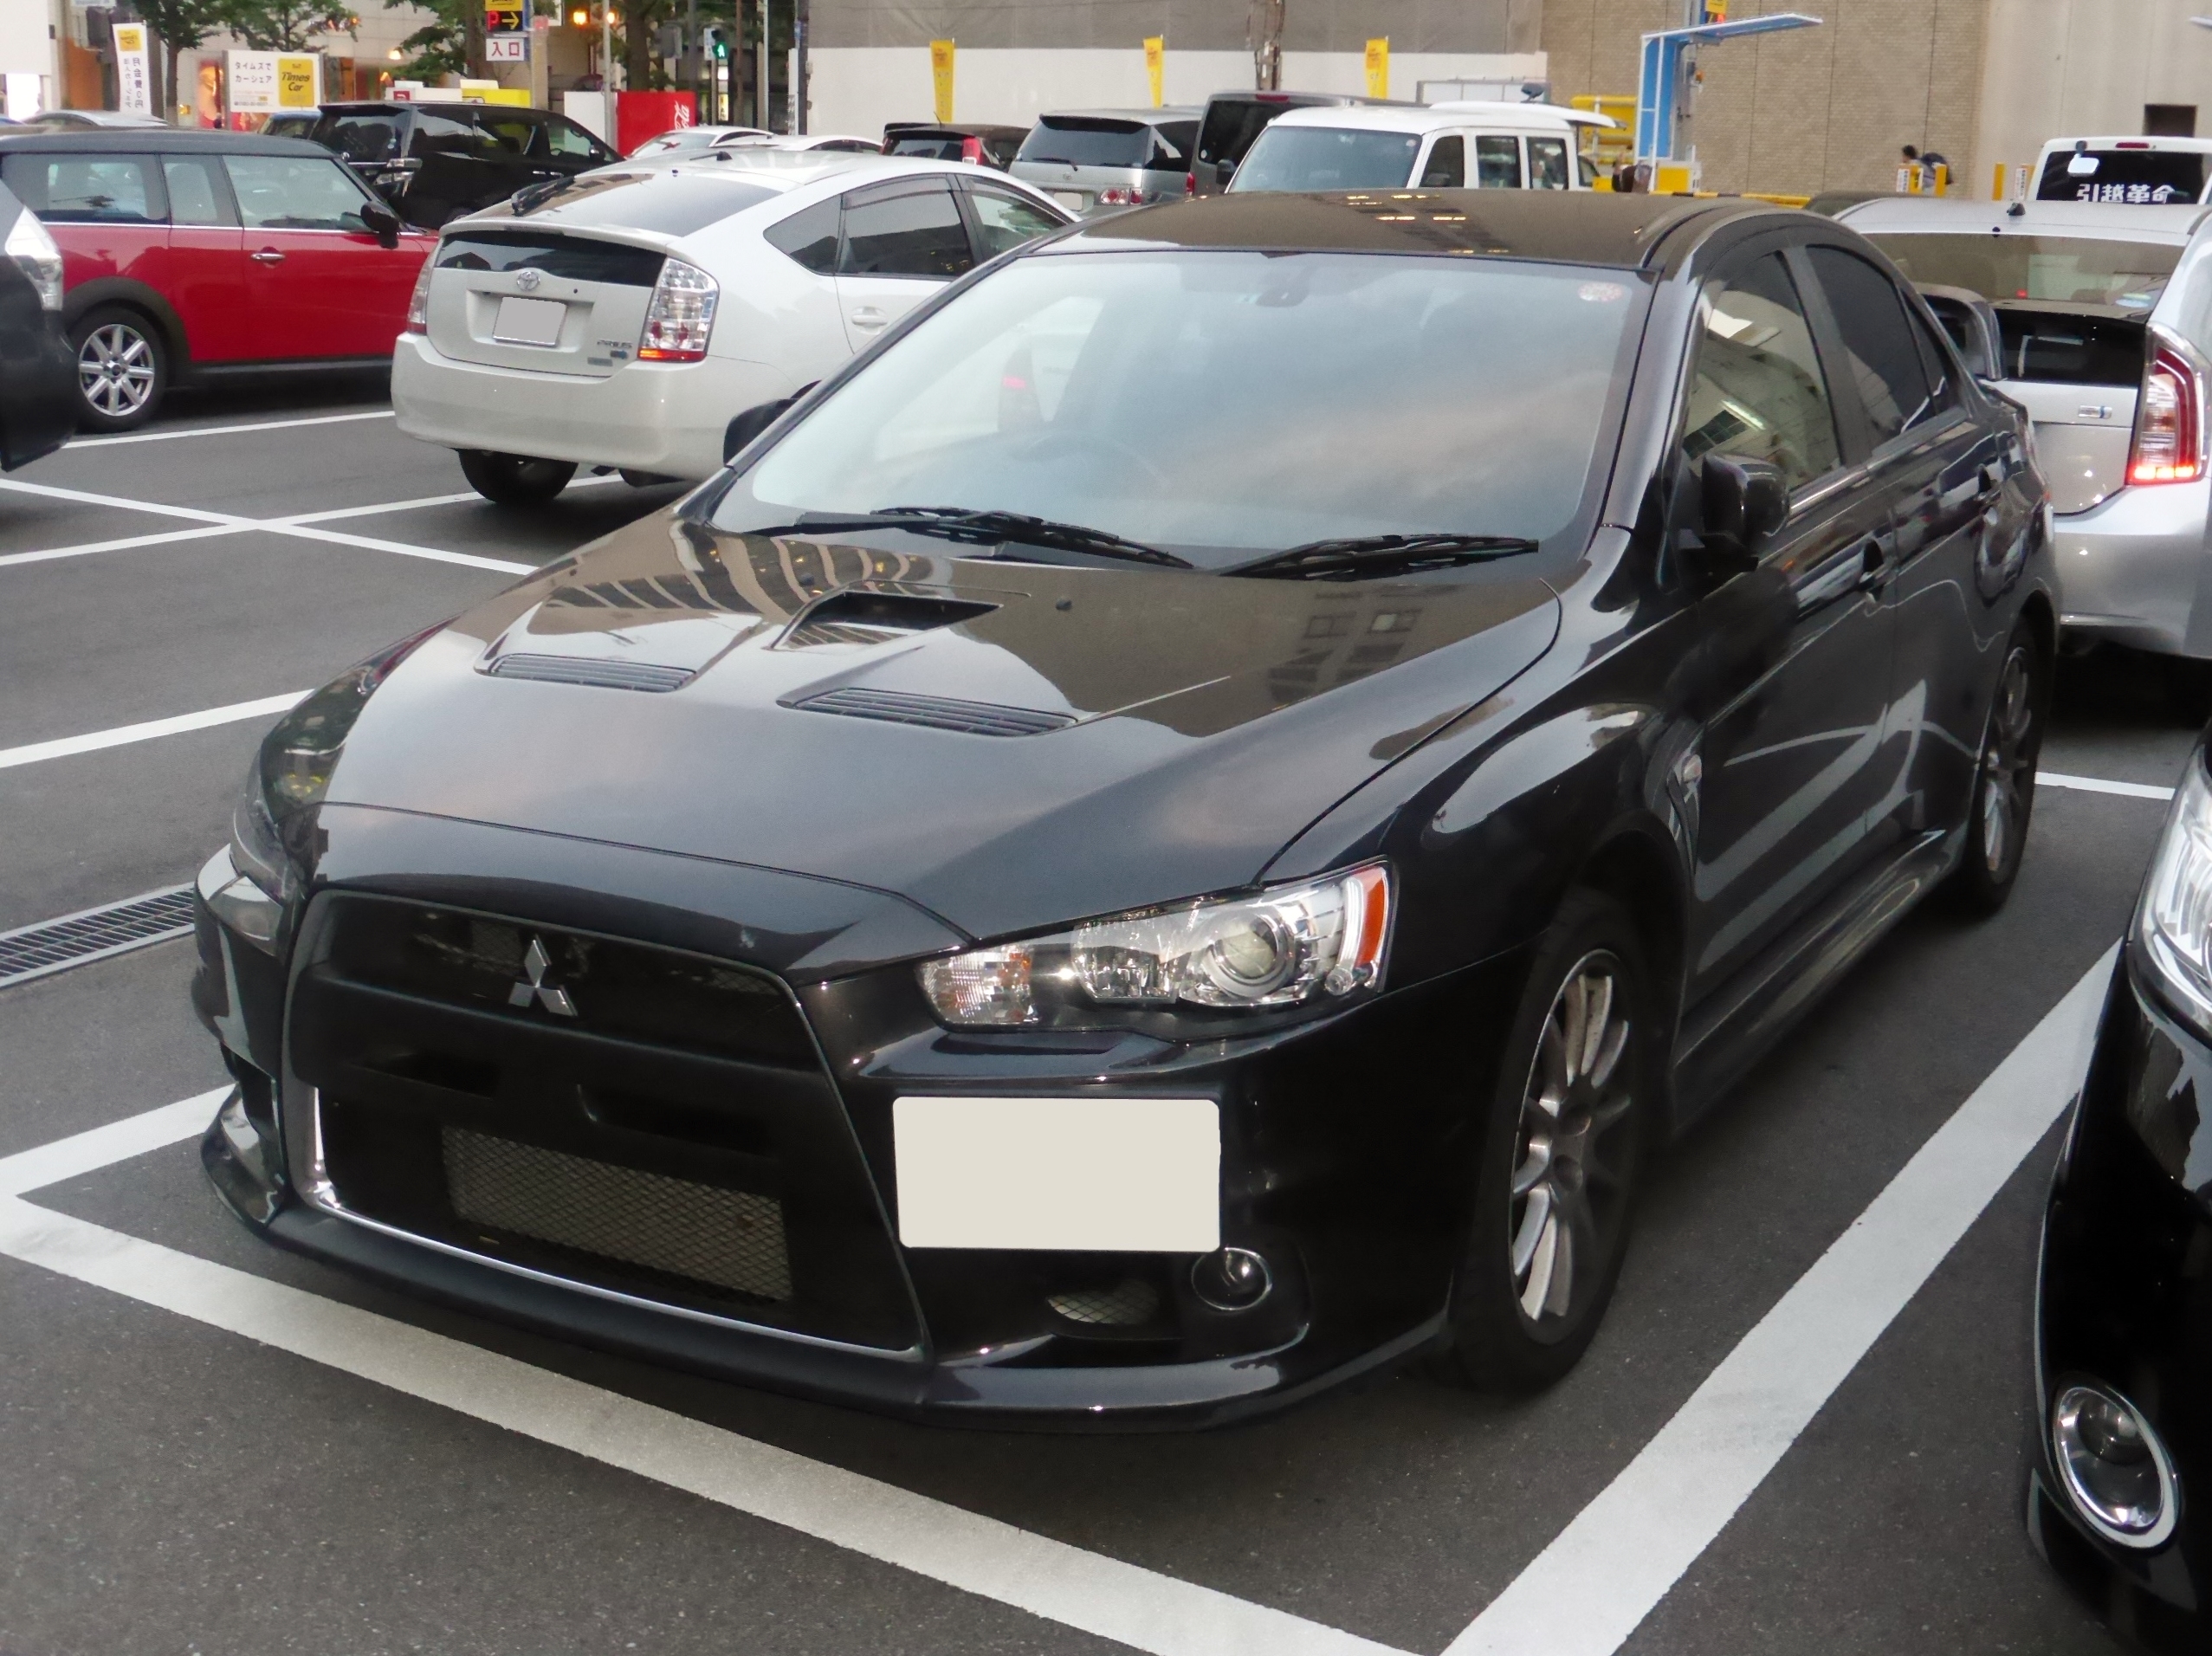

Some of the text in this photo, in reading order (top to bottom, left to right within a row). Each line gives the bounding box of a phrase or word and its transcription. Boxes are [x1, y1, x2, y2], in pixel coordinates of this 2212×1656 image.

[492, 42, 520, 56] 入口
[281, 71, 310, 82] Times
[288, 81, 304, 92] Car
[2077, 184, 2175, 204] 引越革命
